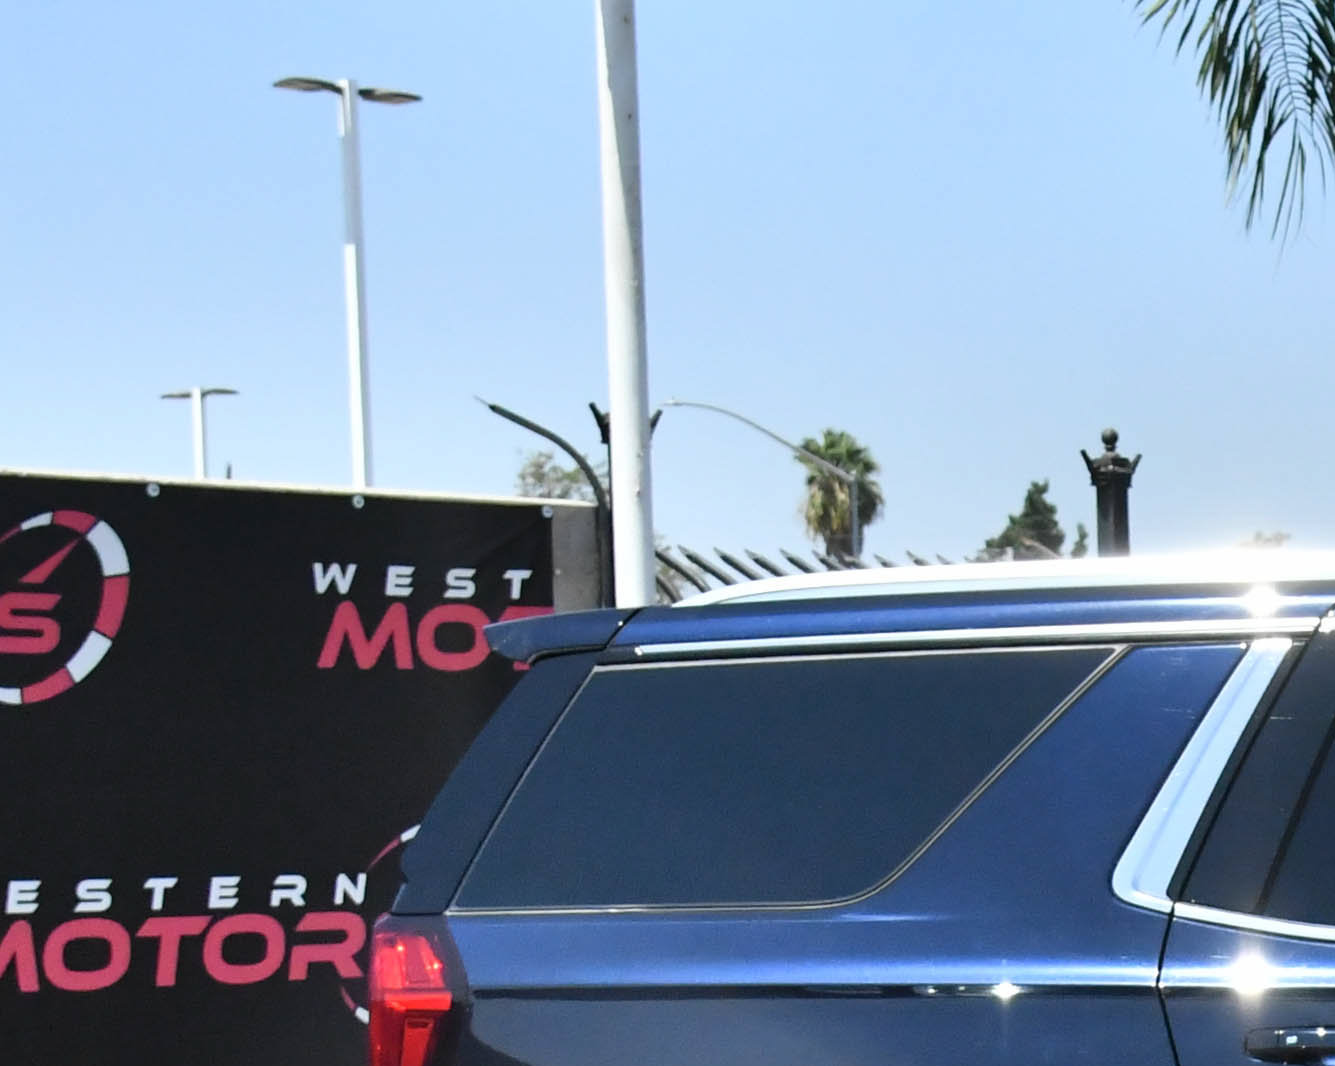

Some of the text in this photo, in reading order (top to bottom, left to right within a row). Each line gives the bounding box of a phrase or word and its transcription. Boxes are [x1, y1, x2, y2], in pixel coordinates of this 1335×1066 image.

[312, 562, 532, 600] WEST
[317, 600, 554, 672] MO
[5, 872, 367, 915] ESTERN
